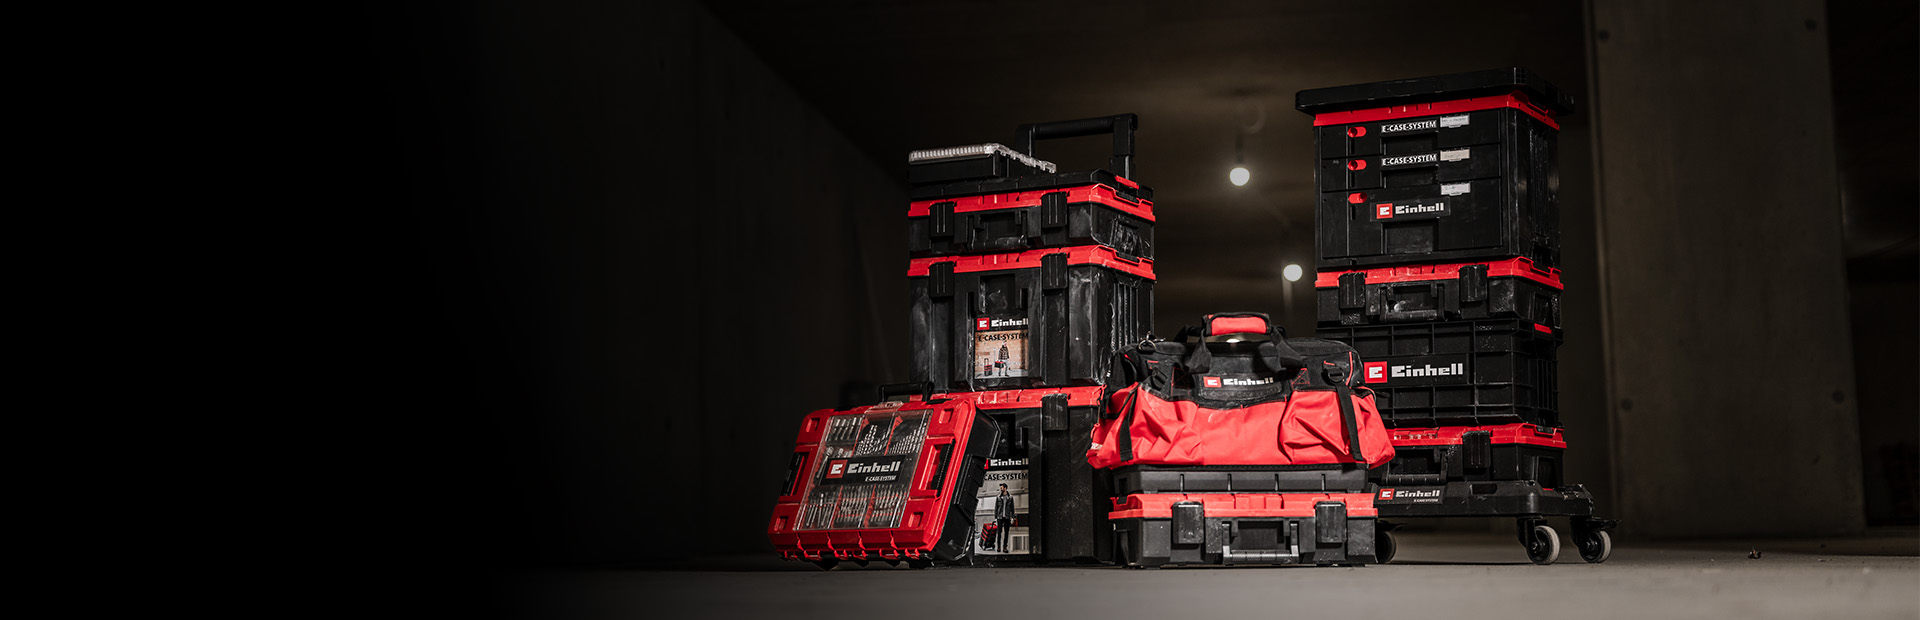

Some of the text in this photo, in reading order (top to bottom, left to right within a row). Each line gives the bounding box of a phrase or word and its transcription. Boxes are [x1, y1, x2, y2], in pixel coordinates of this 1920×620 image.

[1382, 120, 1437, 132] E-CASE-SYSTEM
[1382, 154, 1437, 166] E-CASE-SYSTEM
[1395, 202, 1444, 214] Einhell
[991, 318, 1028, 327] Einhell
[1391, 363, 1464, 378] Einhell
[1223, 376, 1274, 387] Einhell
[846, 460, 901, 475] Einhell
[990, 457, 1029, 467] Einhell
[984, 472, 1028, 481] CASE-SYSTEM
[1395, 489, 1440, 498] Einhell
